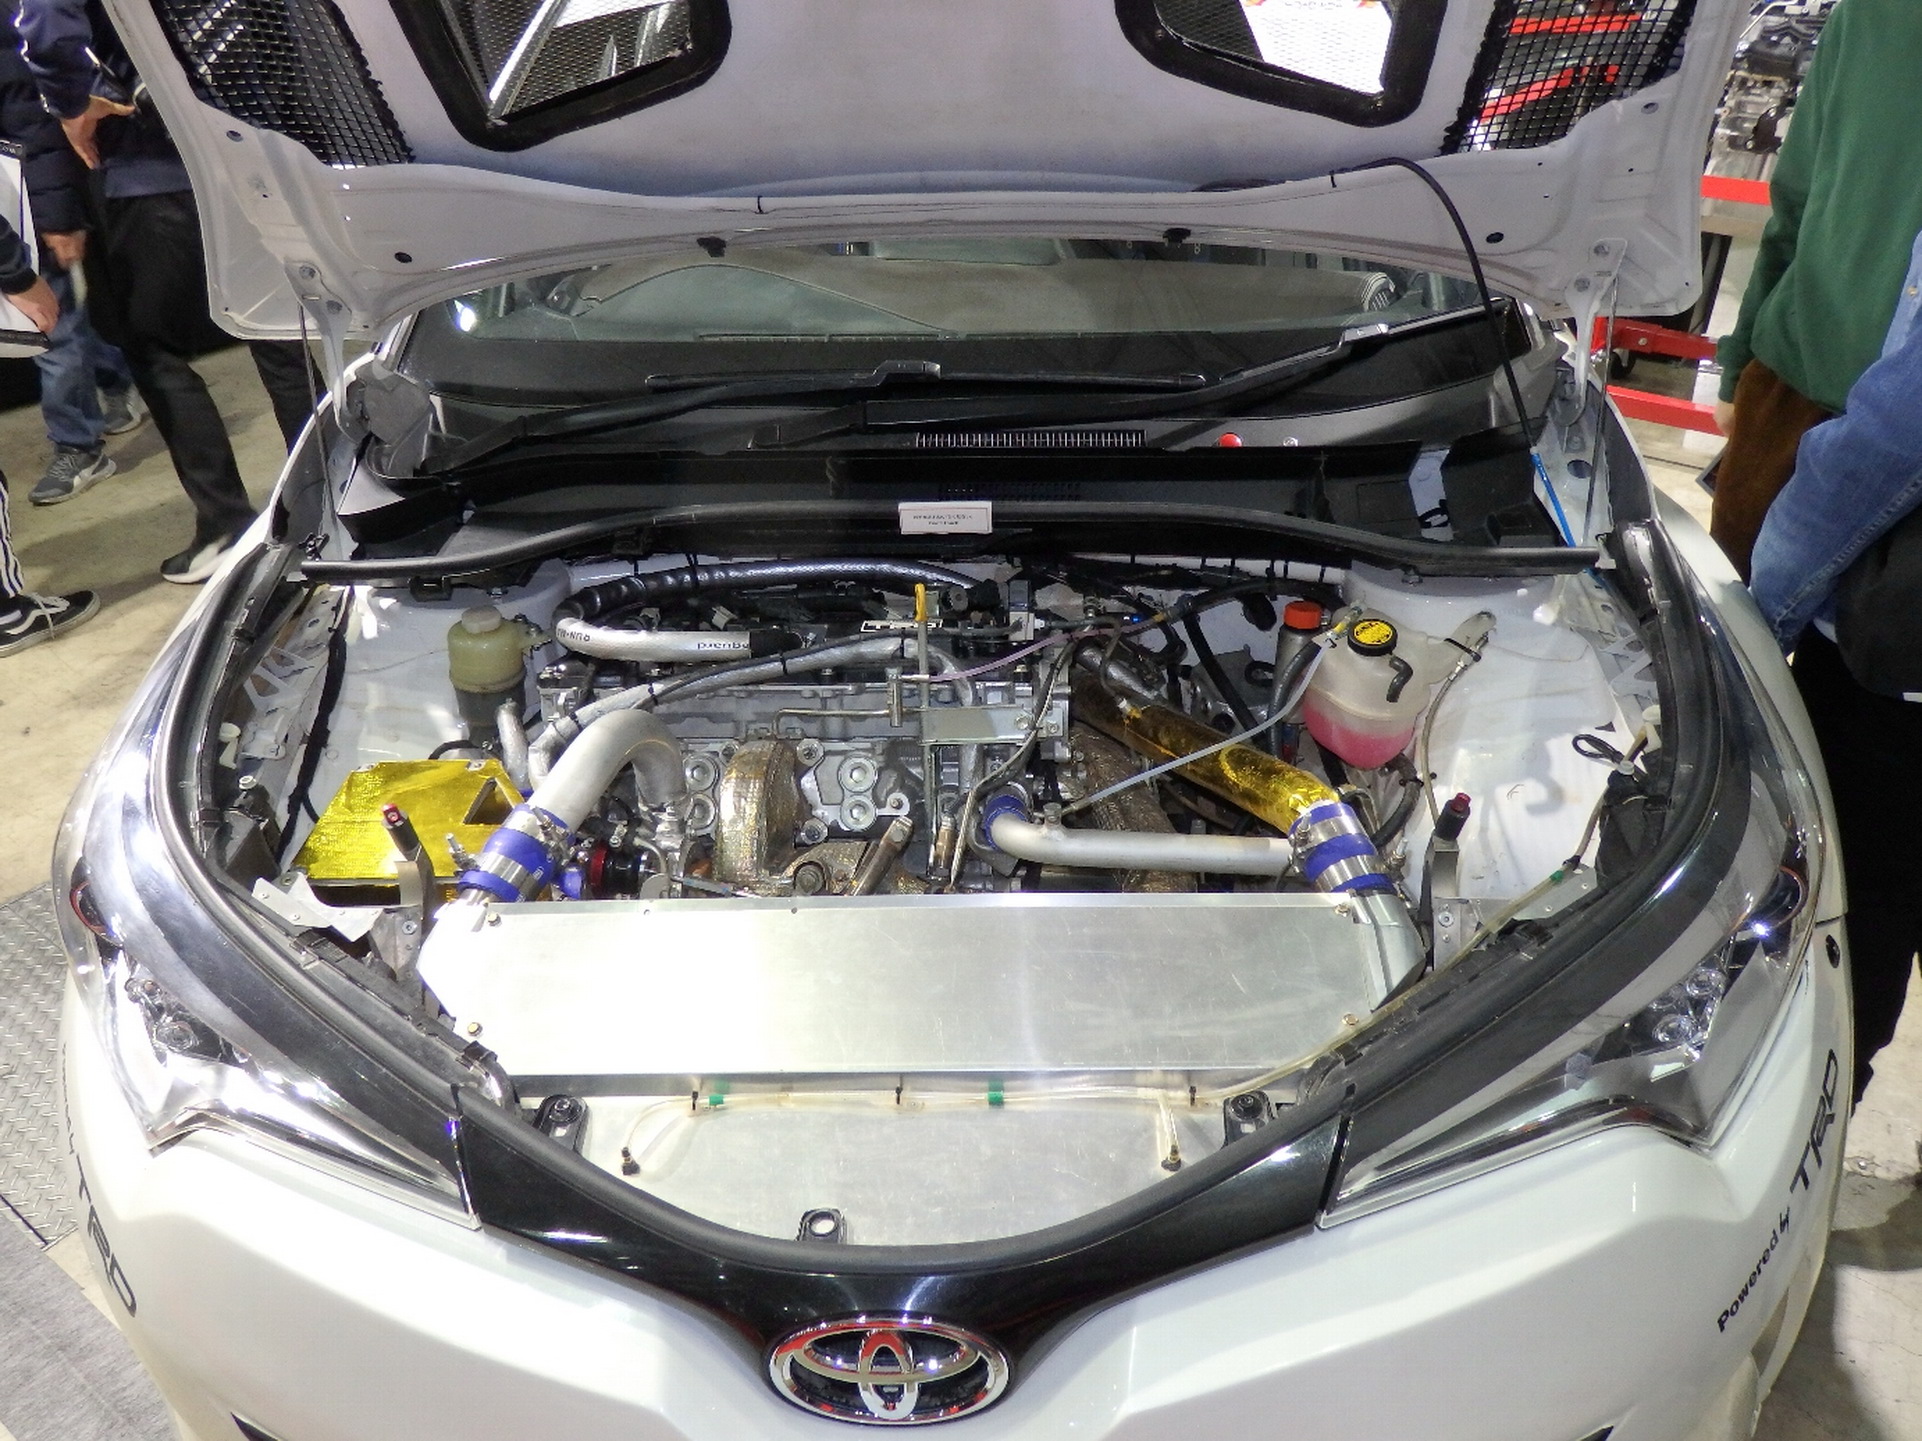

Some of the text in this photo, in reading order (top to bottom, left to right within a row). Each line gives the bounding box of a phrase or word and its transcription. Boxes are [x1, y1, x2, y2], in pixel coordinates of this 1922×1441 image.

[76, 1154, 137, 1318] TRD
[1717, 1048, 1838, 1333] Powered by TRD
